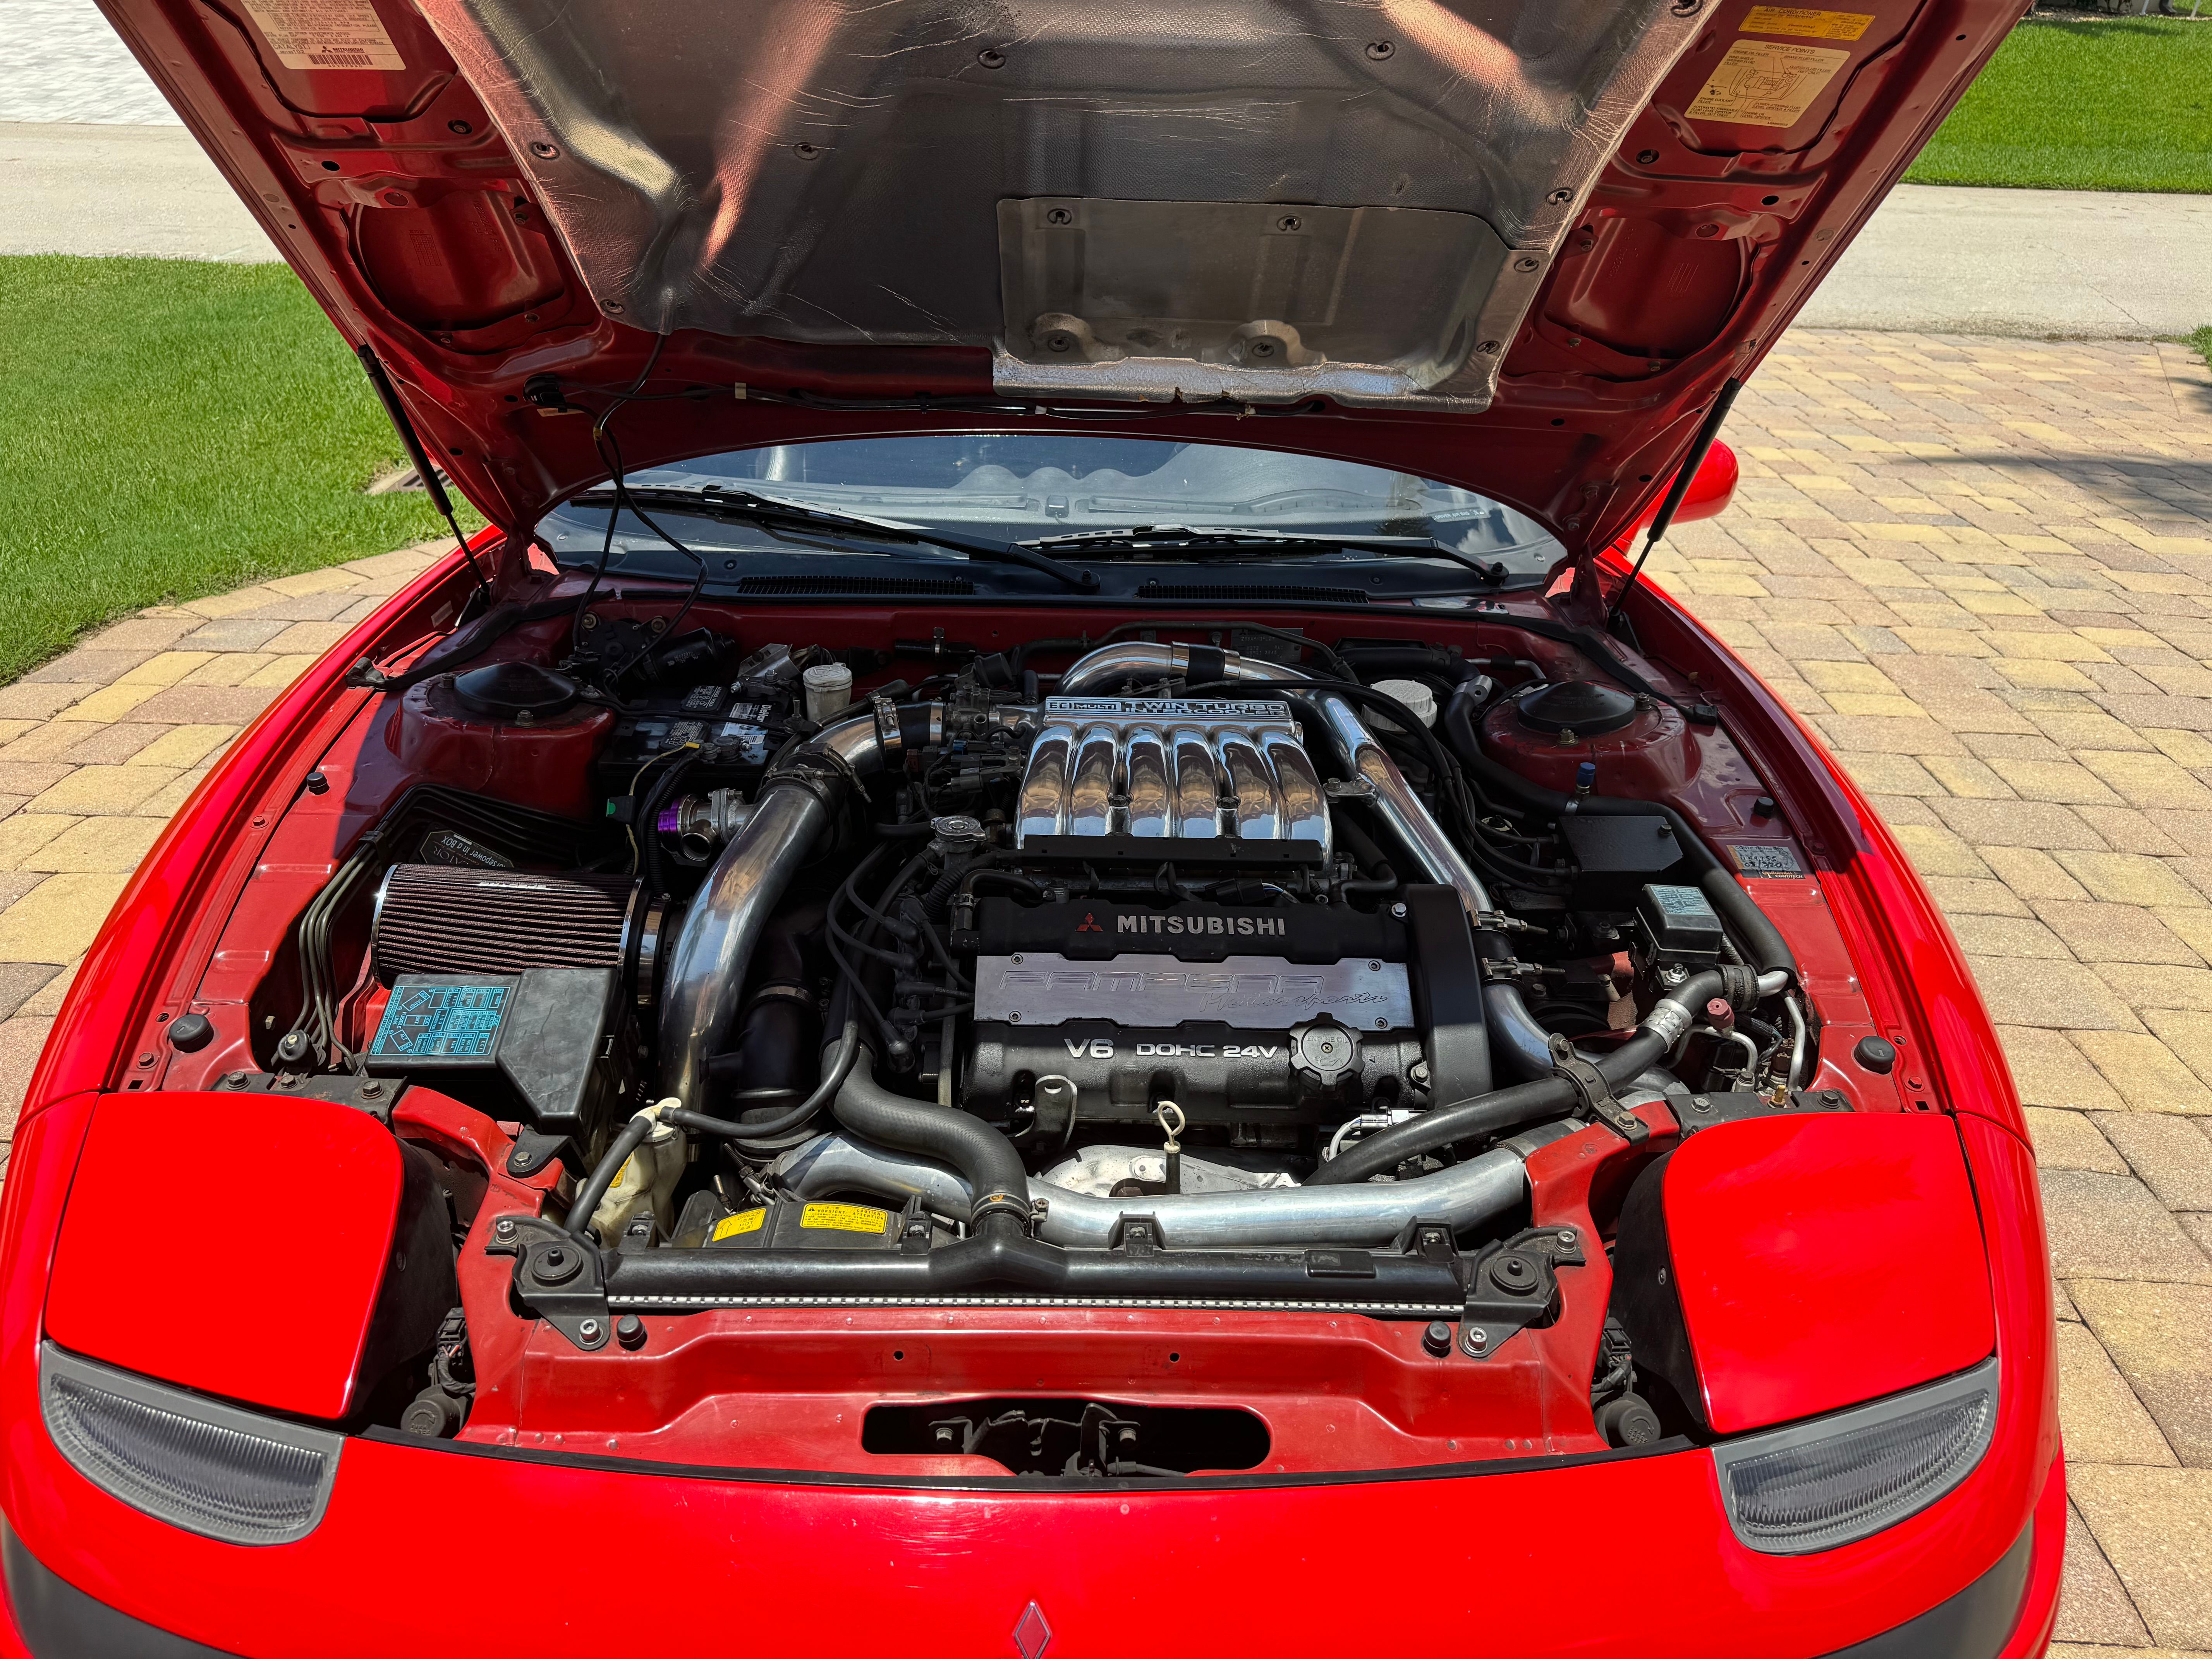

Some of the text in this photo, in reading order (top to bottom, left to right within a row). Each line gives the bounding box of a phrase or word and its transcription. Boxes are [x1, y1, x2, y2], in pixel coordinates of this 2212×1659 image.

[1125, 701, 1285, 711] TWIN TURBO
[441, 835, 457, 848] BOX
[463, 846, 471, 855] in
[1117, 915, 1285, 936] MITSUBISHI
[396, 1011, 407, 1029] FUSIBLE
[1064, 1038, 1278, 1059] V6 DOHC 24V
[737, 1211, 761, 1220] DANGER
[852, 1212, 884, 1220] ATTENTION
